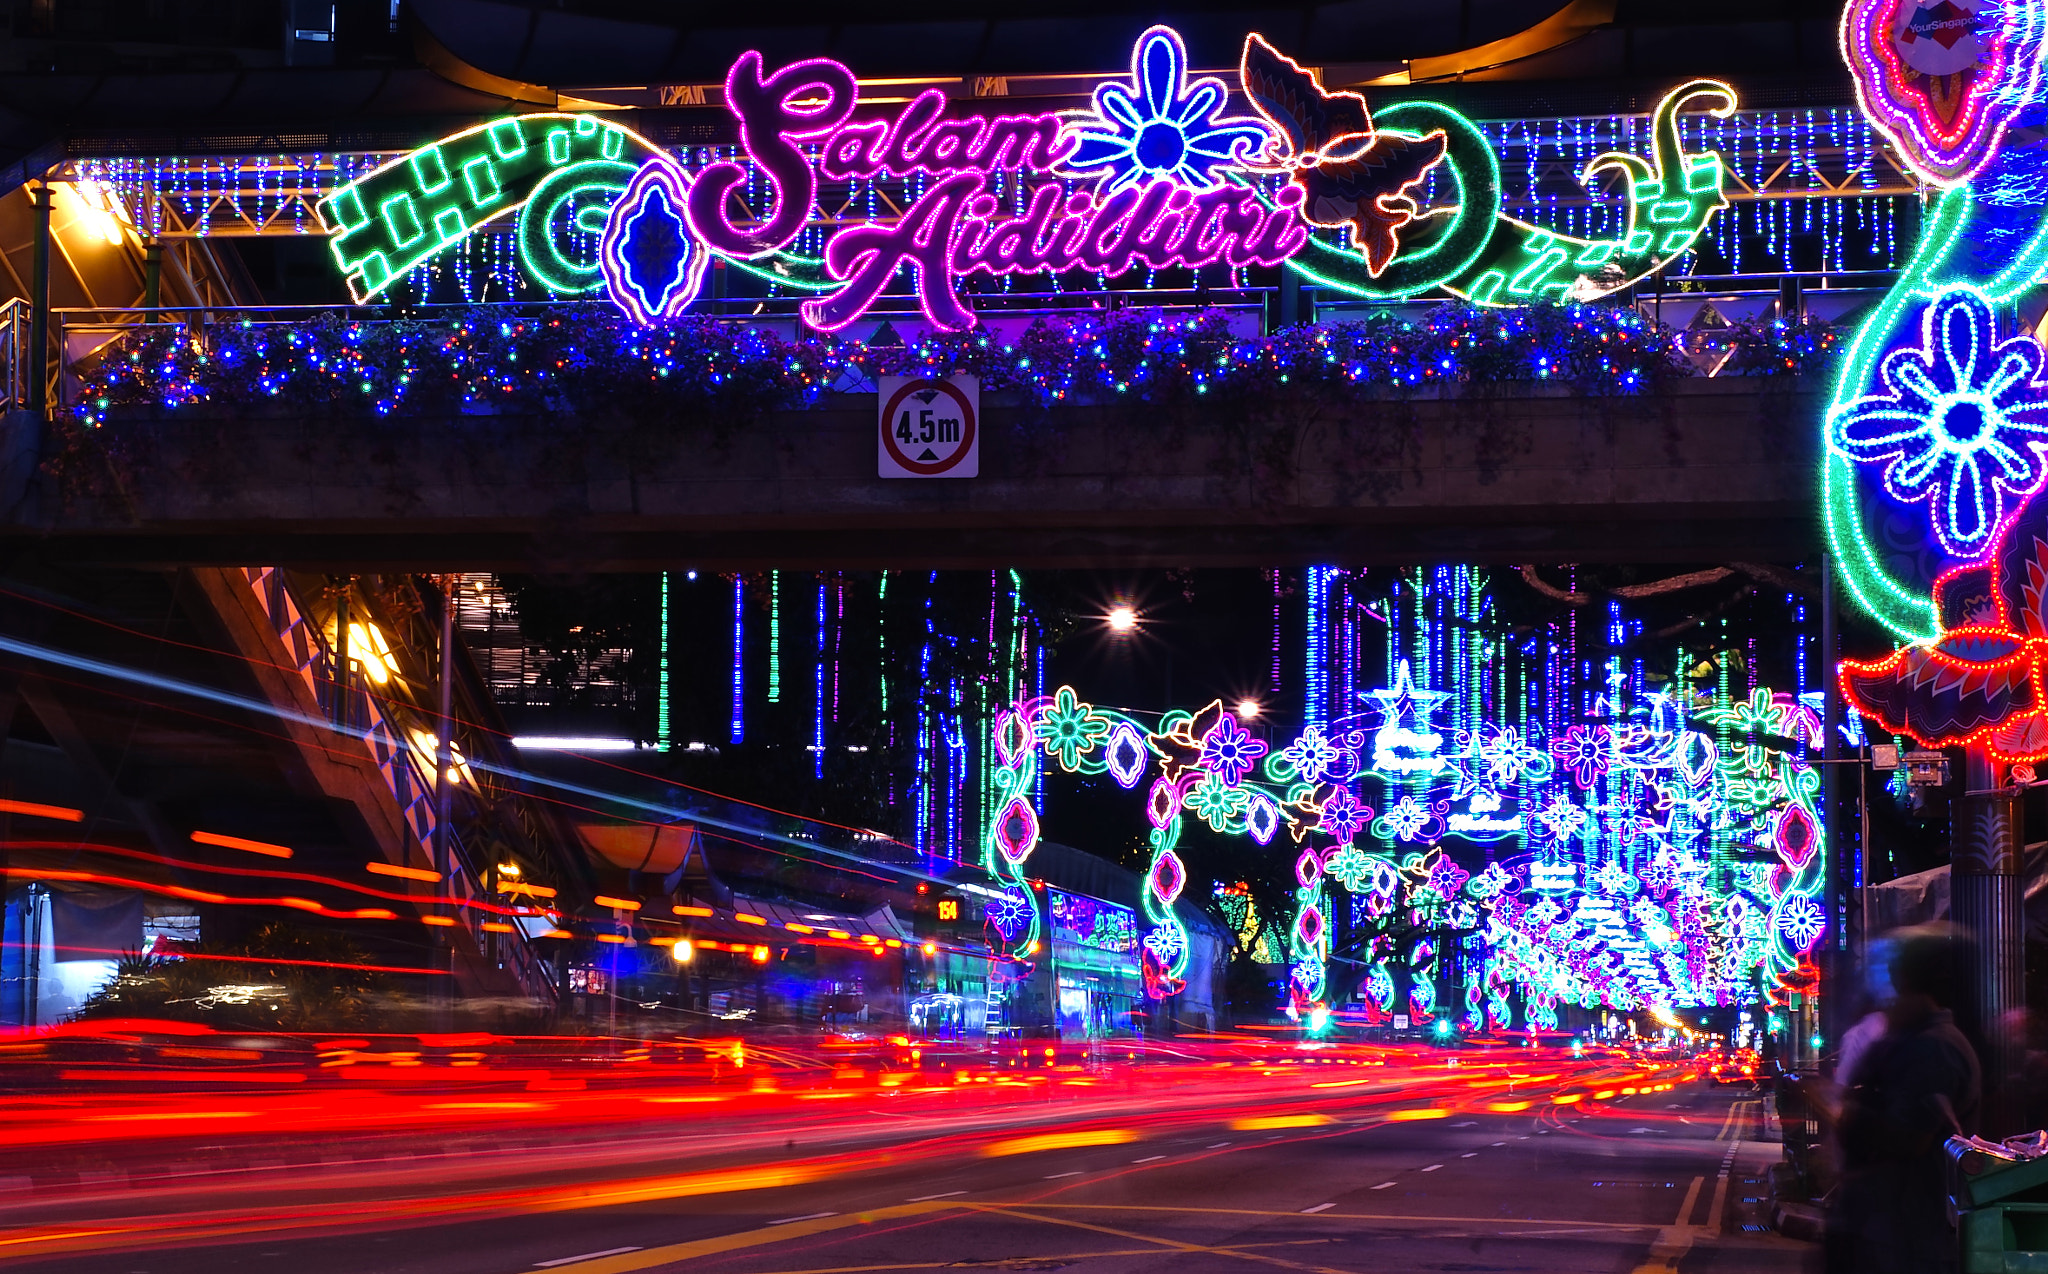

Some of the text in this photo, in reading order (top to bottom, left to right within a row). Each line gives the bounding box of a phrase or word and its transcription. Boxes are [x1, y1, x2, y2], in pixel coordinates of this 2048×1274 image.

[688, 50, 1077, 259] Salam
[801, 168, 1307, 332] Aidilfitri
[896, 410, 960, 444] 4.5m
[938, 901, 958, 920] 154
